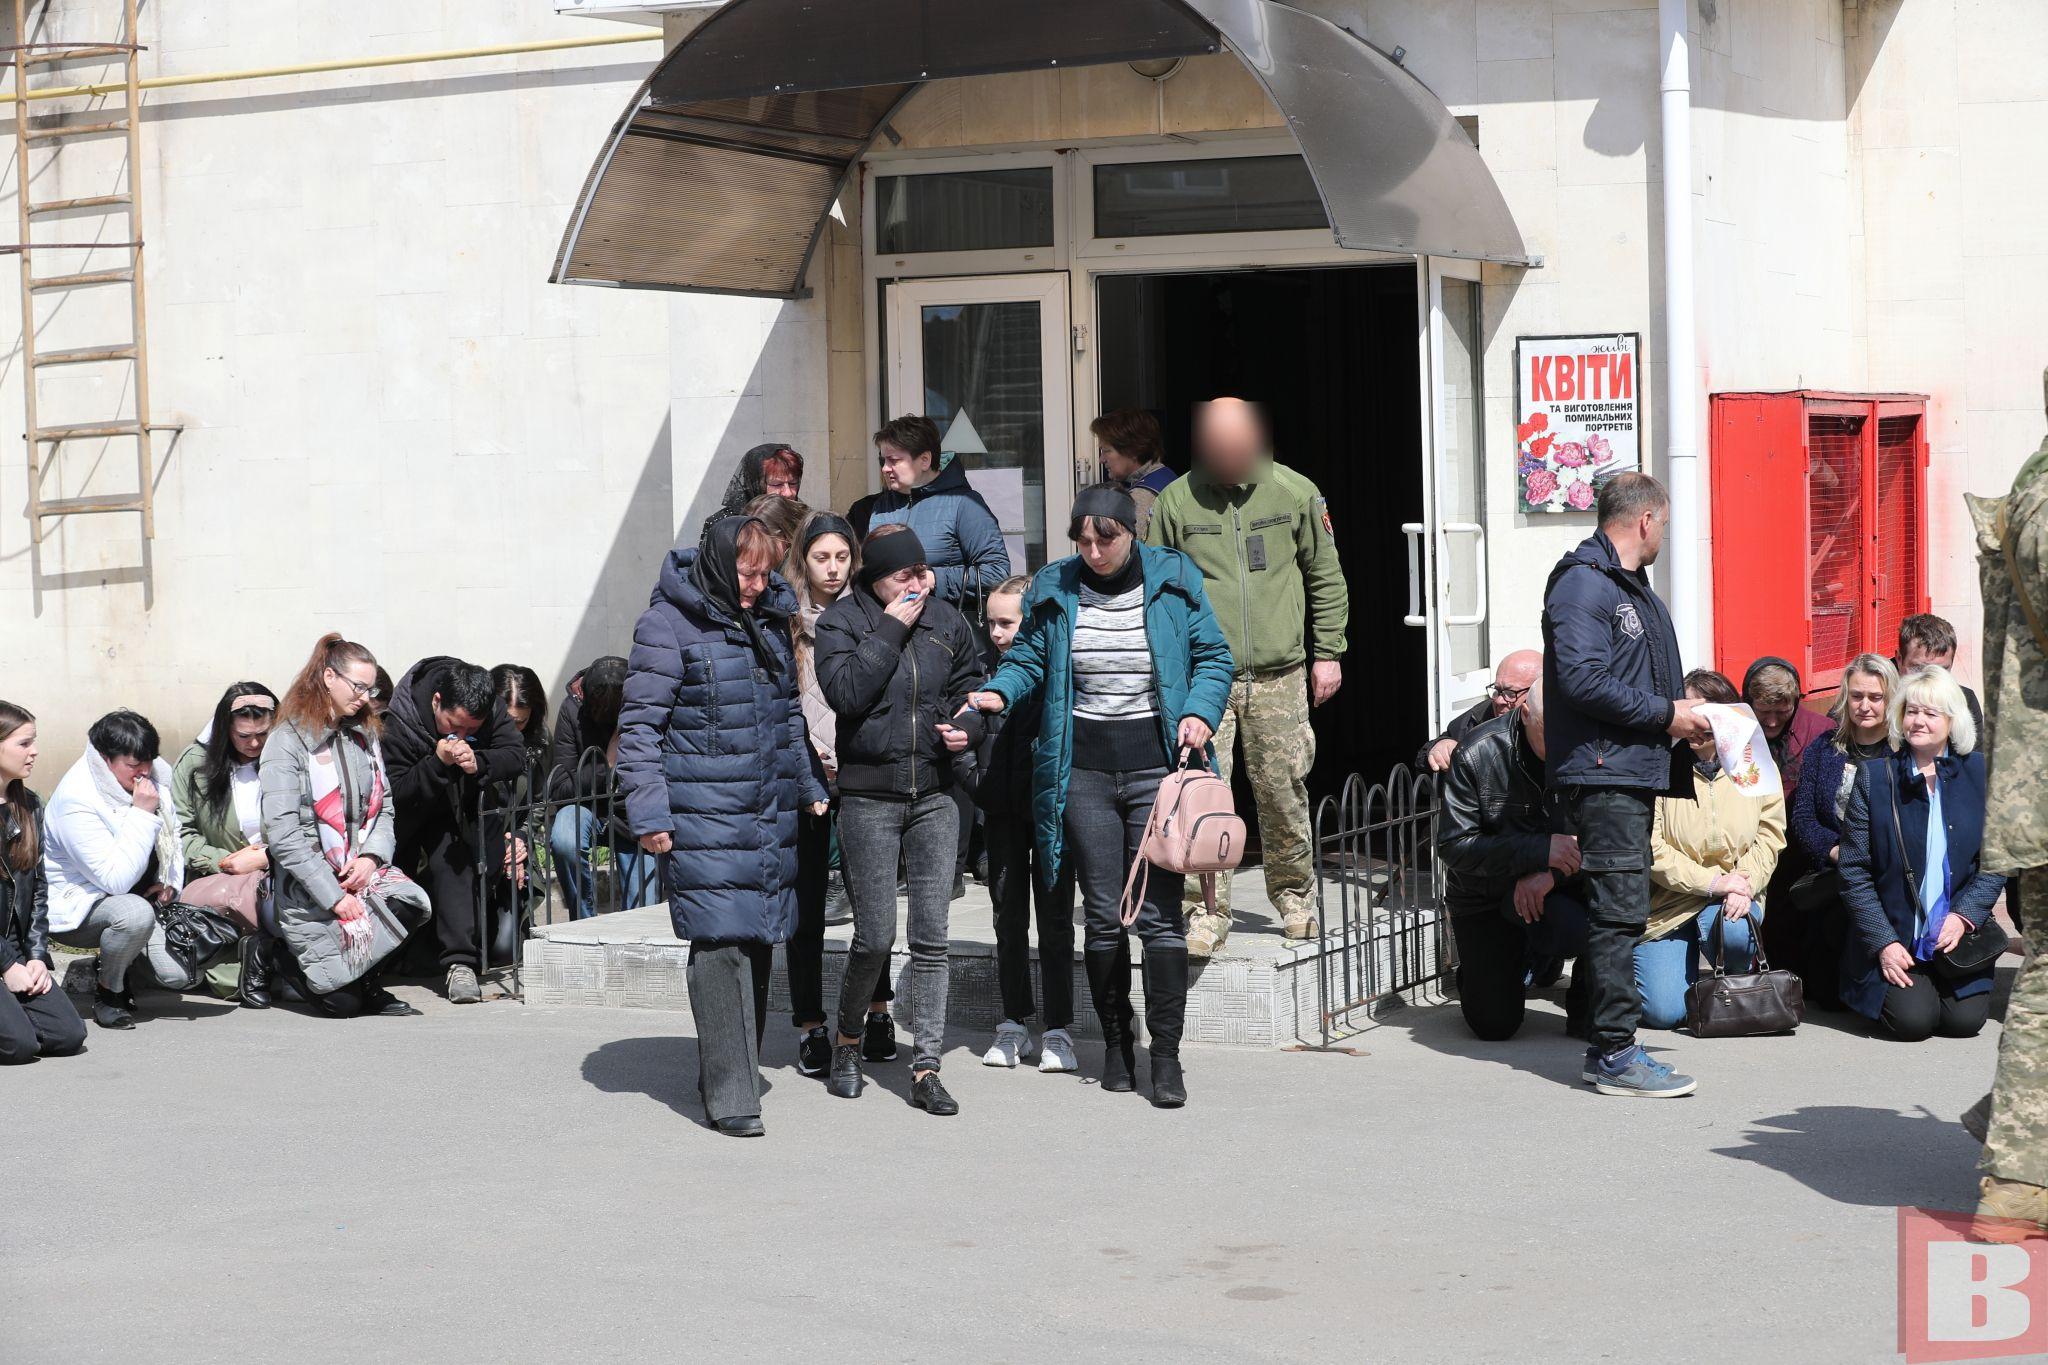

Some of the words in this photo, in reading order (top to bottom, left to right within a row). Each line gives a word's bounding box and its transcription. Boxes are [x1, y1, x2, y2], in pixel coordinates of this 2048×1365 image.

[1591, 334, 1631, 353] живі
[1531, 353, 1632, 402] КВІТИ
[1549, 404, 1561, 413] ТА
[1564, 402, 1633, 413] ВИГОТОВЛЕННЯ
[1565, 412, 1633, 423] ПОМИНАЛЬНИХ
[1585, 422, 1633, 432] ПОРТРЕТІВ
